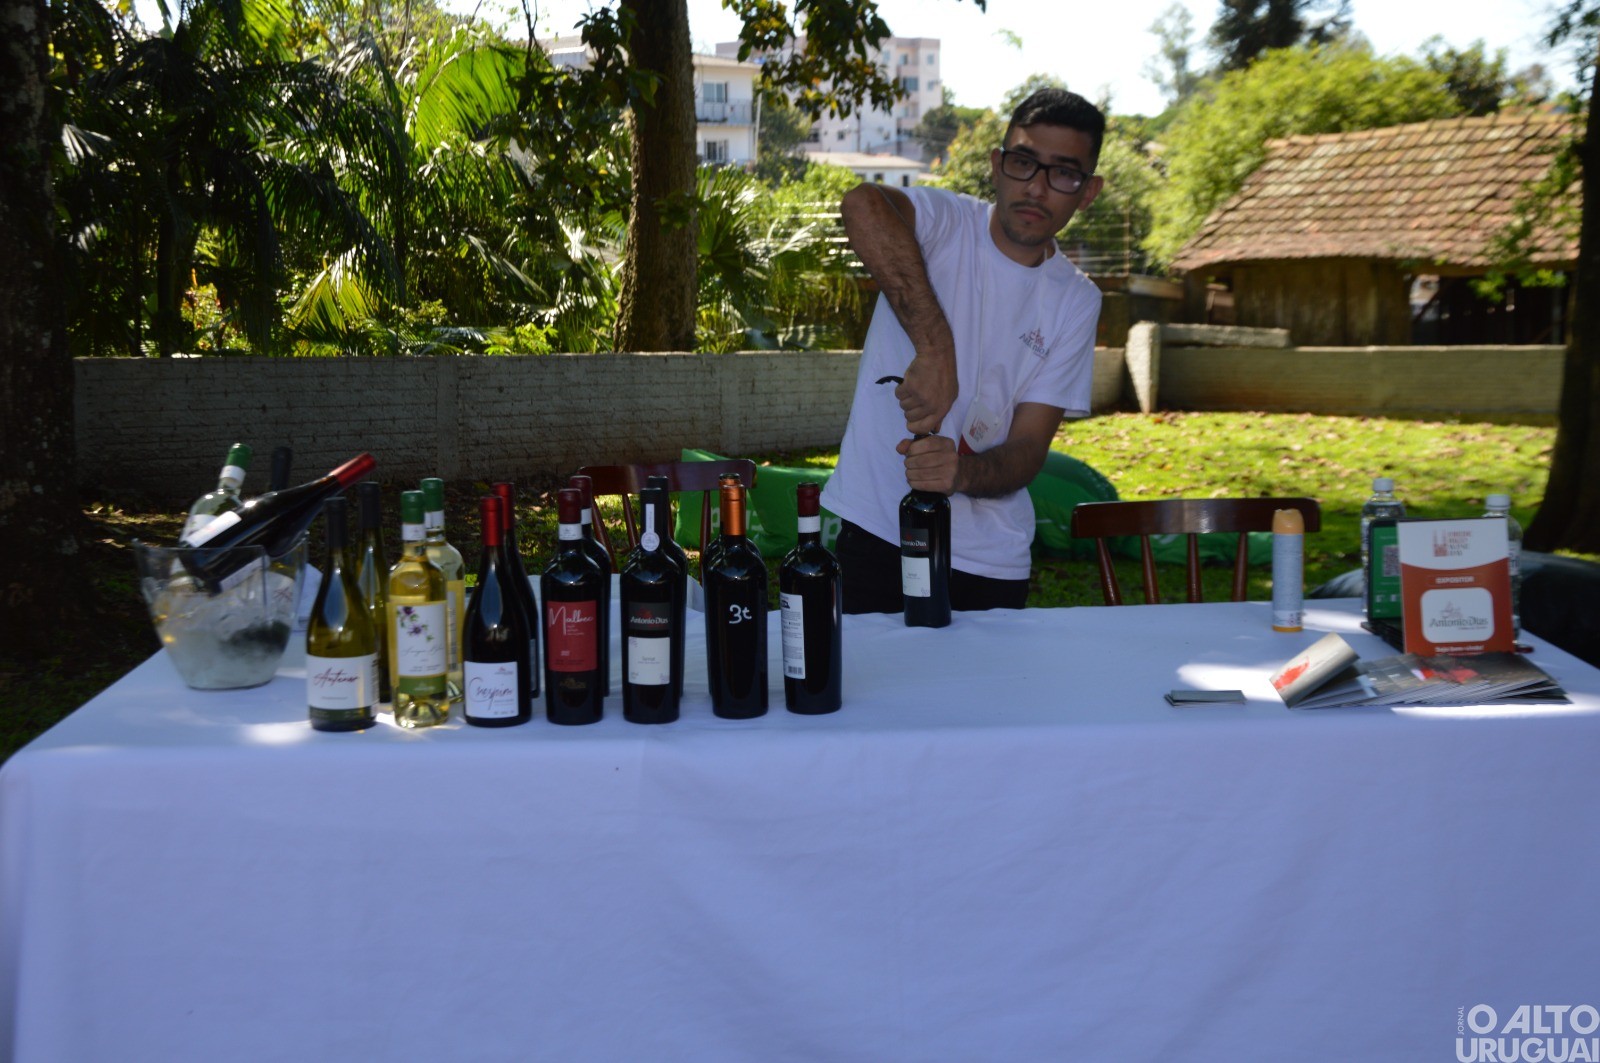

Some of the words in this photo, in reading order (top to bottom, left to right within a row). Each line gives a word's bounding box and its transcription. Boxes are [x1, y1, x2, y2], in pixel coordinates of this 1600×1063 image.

[728, 604, 752, 624] 3t
[630, 616, 655, 625] Antonio
[1429, 616, 1468, 627] Antonio
[1468, 615, 1489, 626] Dias
